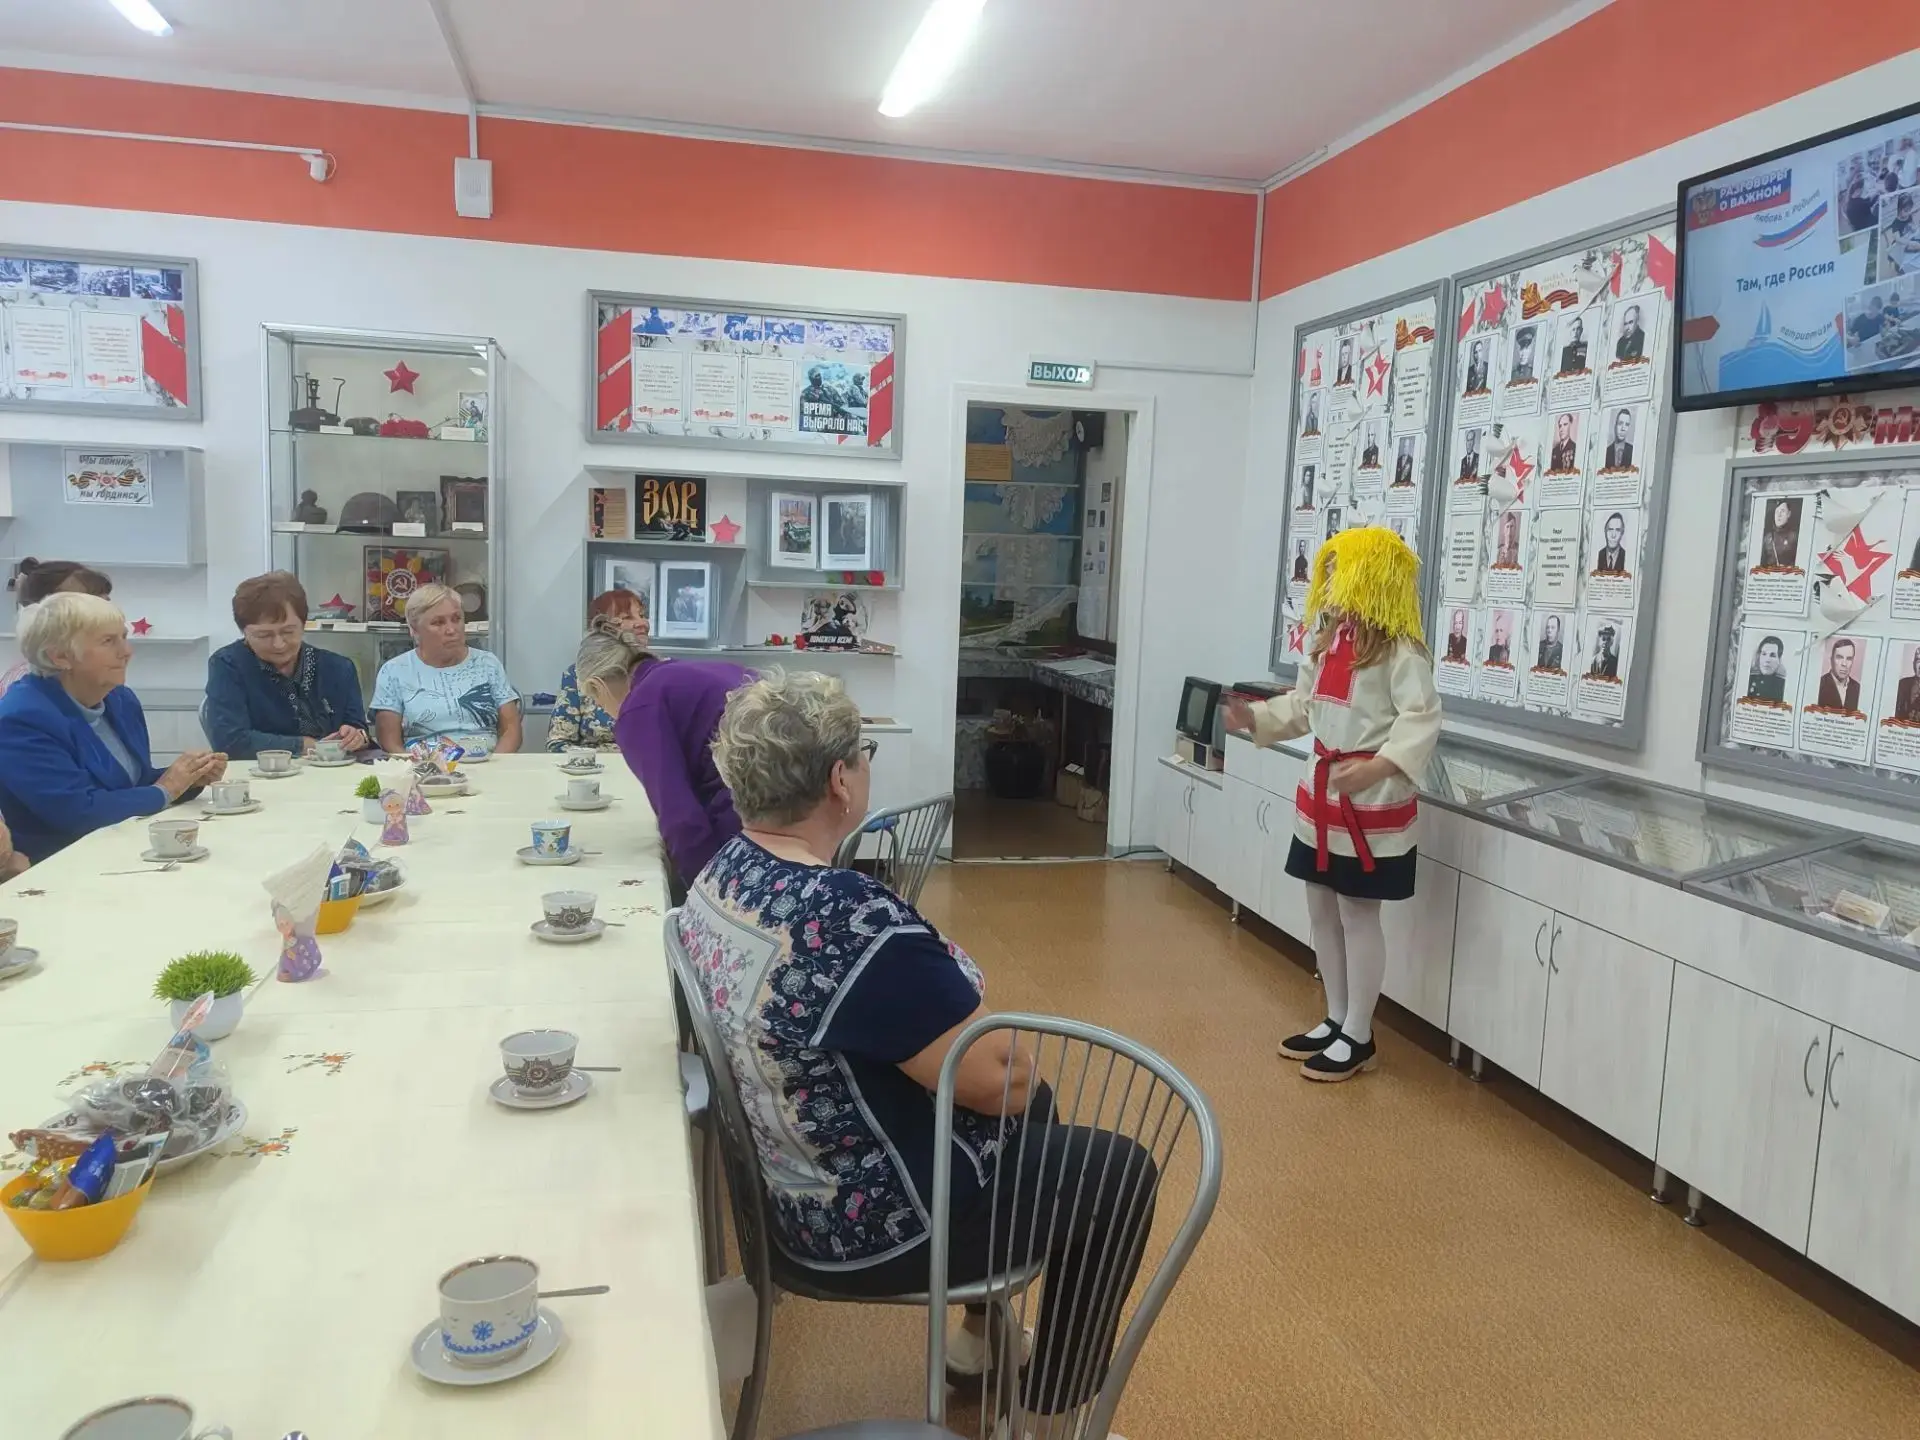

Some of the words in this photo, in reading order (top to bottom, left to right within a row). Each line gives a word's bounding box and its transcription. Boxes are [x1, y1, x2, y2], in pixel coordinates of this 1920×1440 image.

[1720, 169, 1788, 198] РАЗГОВОРЫ
[1720, 200, 1728, 212] О
[1730, 184, 1783, 209] ВАЖНОМ
[1736, 278, 1762, 293] Там,
[1764, 272, 1785, 289] где
[1789, 260, 1835, 281] Россия
[1033, 364, 1090, 382] ВЫХОД
[803, 402, 832, 416] ВРЕМЯ
[803, 415, 845, 431] ВЫБРАЛО
[846, 418, 864, 432] НАС
